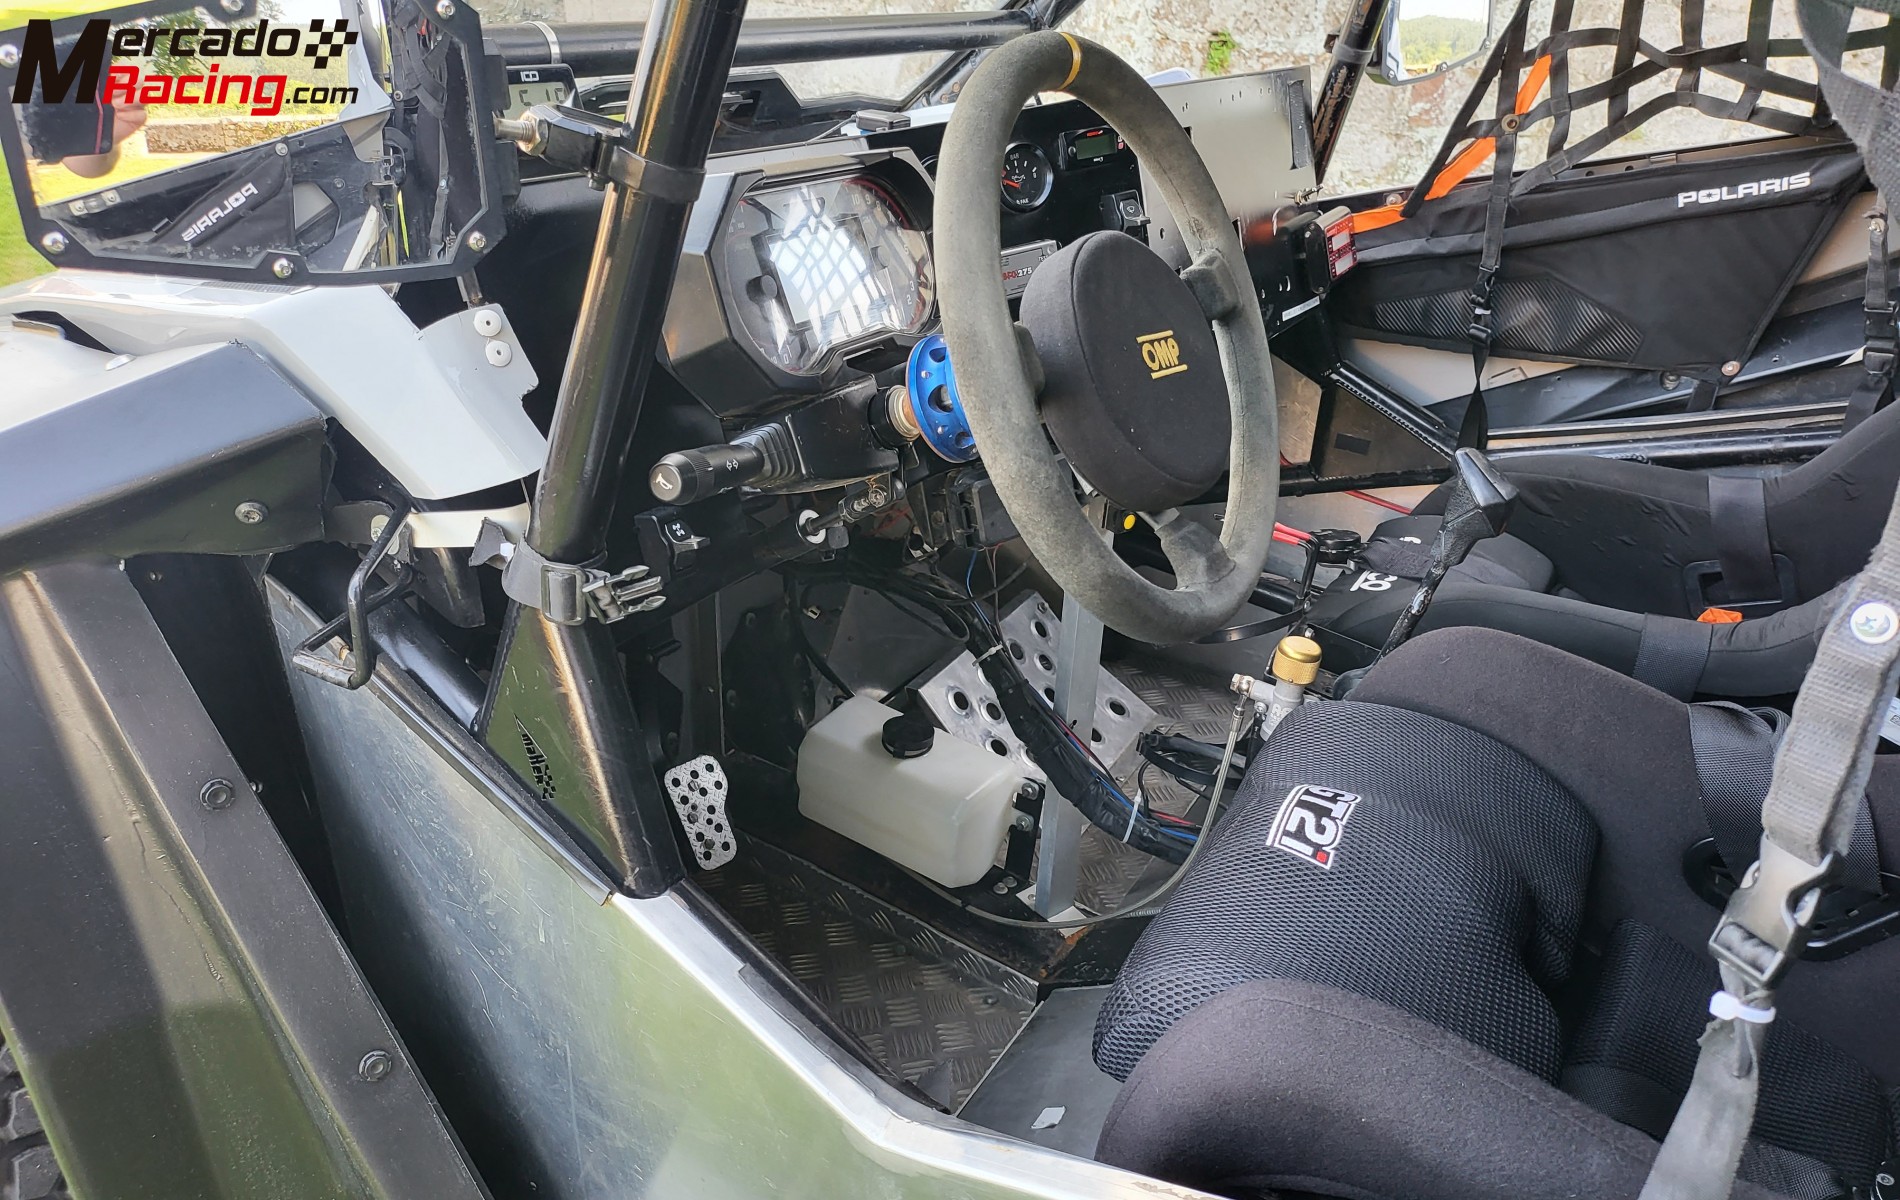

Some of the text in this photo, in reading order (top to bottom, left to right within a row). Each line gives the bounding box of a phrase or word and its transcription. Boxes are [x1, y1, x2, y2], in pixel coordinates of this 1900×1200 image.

[1677, 171, 1811, 208] POLARIS
[1142, 337, 1180, 371] OMP
[1280, 787, 1358, 864] GT2i
